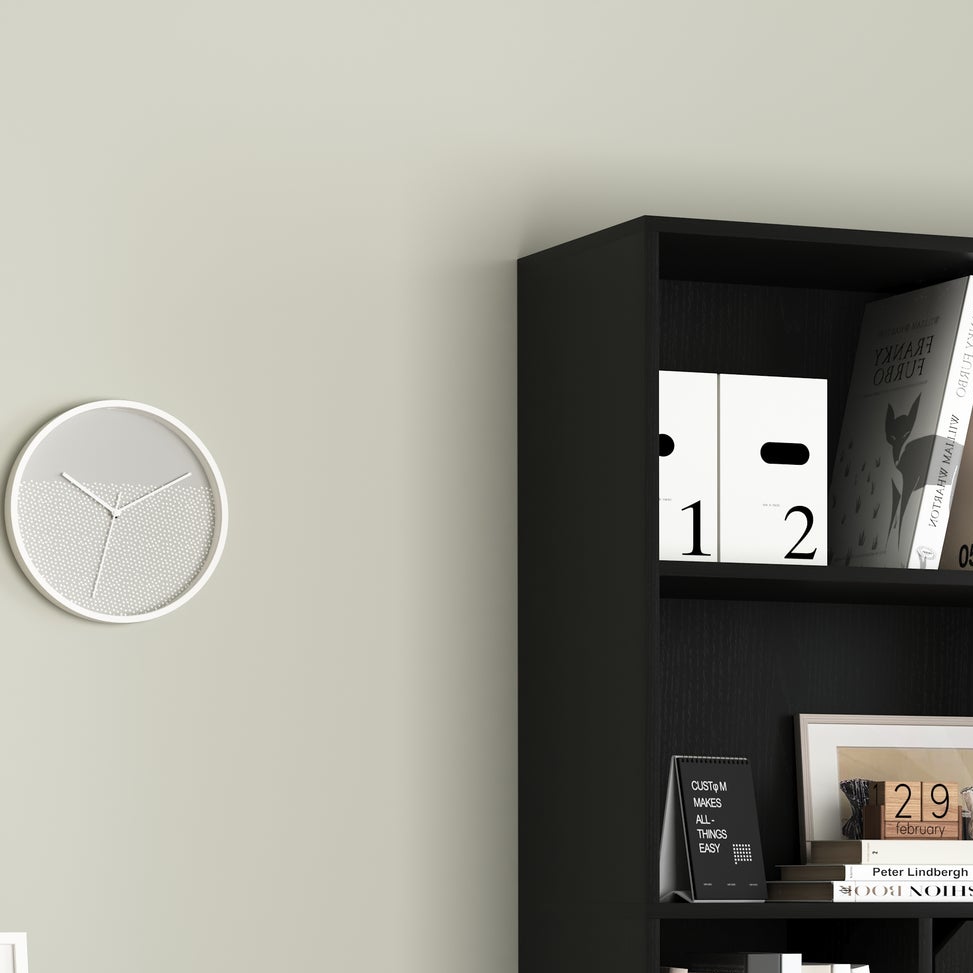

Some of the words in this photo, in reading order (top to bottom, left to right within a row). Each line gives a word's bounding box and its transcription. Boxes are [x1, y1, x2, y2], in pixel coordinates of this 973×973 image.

[681, 500, 711, 556] 1
[784, 505, 817, 559] 2
[693, 798, 722, 808] MAKES
[697, 829, 728, 839] THINGS
[896, 821, 946, 838] february
[699, 843, 720, 853] EASY
[873, 867, 904, 877] Peter
[907, 867, 969, 879] Lindbergh
